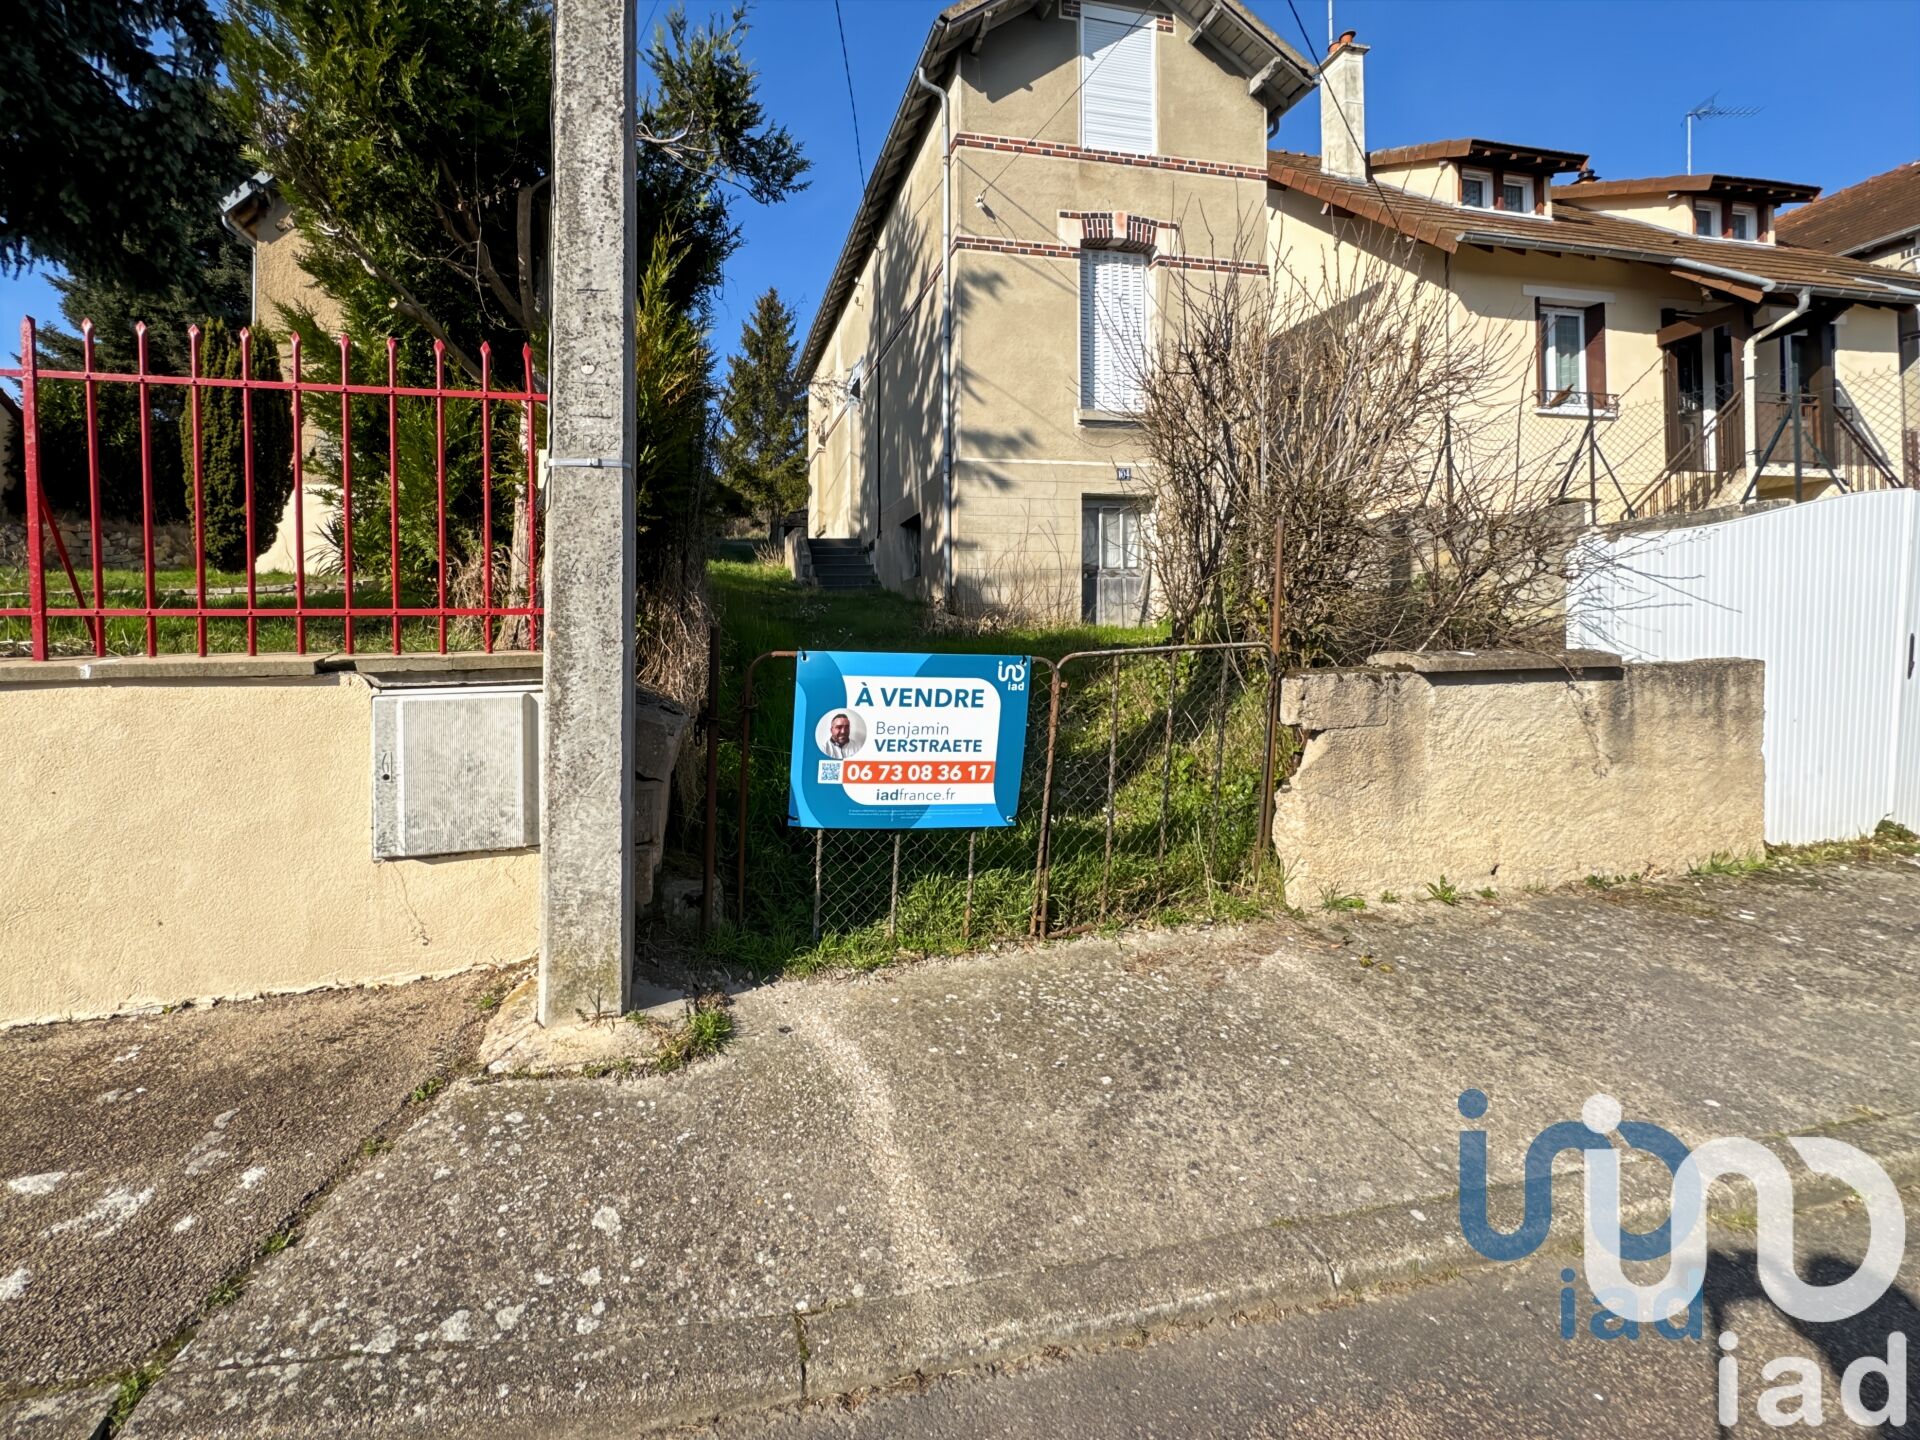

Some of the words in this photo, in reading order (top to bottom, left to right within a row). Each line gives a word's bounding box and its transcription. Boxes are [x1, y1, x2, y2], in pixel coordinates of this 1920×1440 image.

[1007, 682, 1025, 691] iad
[855, 682, 873, 707] À
[880, 687, 984, 708] VENDRE
[876, 721, 949, 738] Benjamin
[875, 739, 982, 753] VERSTRAETE
[847, 764, 872, 781] 06
[879, 764, 902, 781] 73
[908, 765, 932, 781] 08
[937, 765, 962, 781] 36
[968, 765, 991, 781] 17
[876, 788, 956, 801] iadfrance.fr
